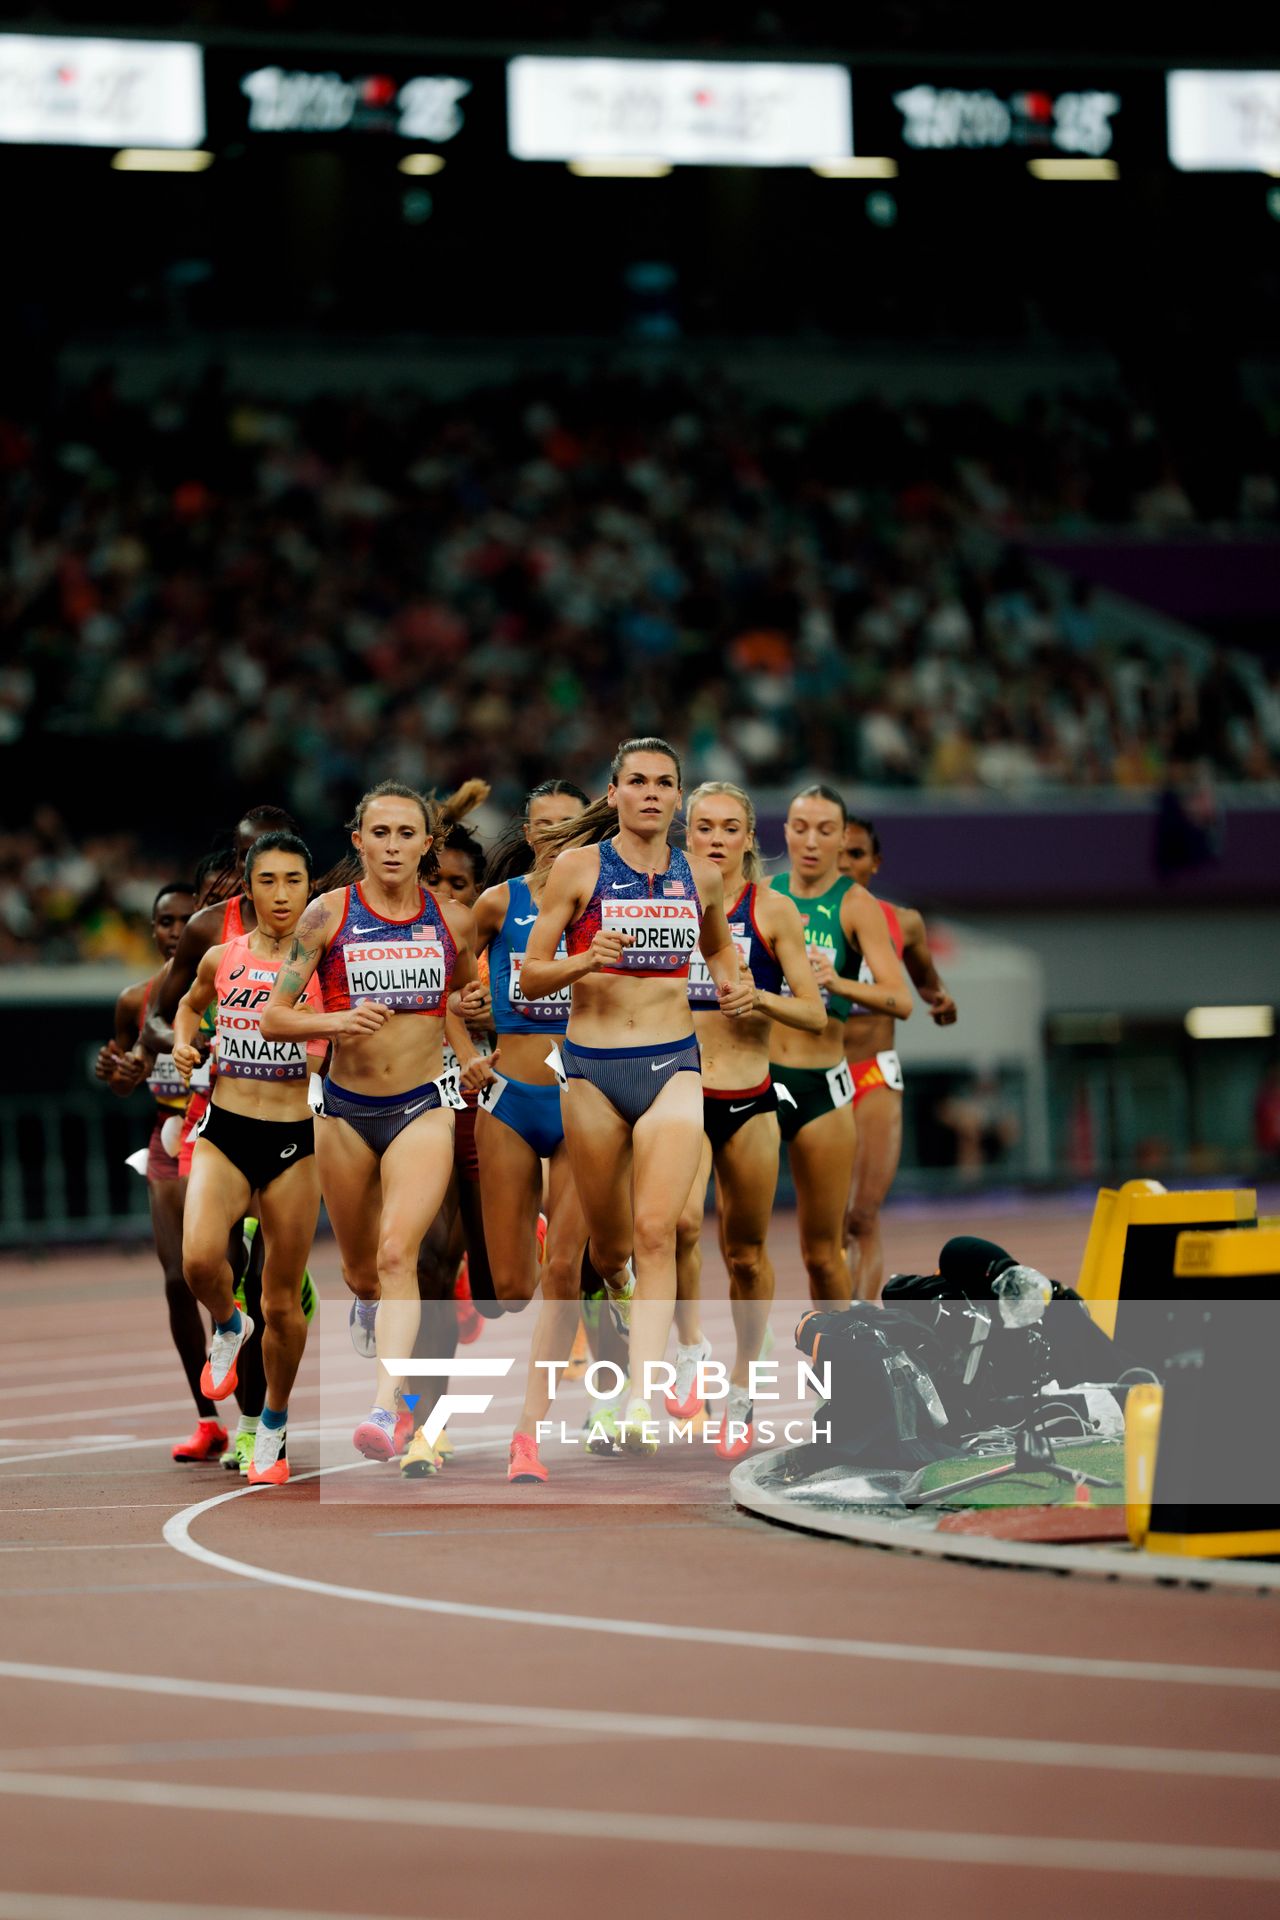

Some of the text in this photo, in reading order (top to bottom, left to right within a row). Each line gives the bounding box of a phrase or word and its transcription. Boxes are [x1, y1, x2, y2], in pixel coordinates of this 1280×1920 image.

[604, 905, 696, 919] HONDA
[611, 927, 696, 949] NDREWS
[345, 946, 442, 963] HONDA
[351, 967, 441, 993] HOULIHAN
[220, 987, 307, 1010] JAP
[219, 1015, 261, 1031] HON
[222, 1035, 302, 1062] TANAKA
